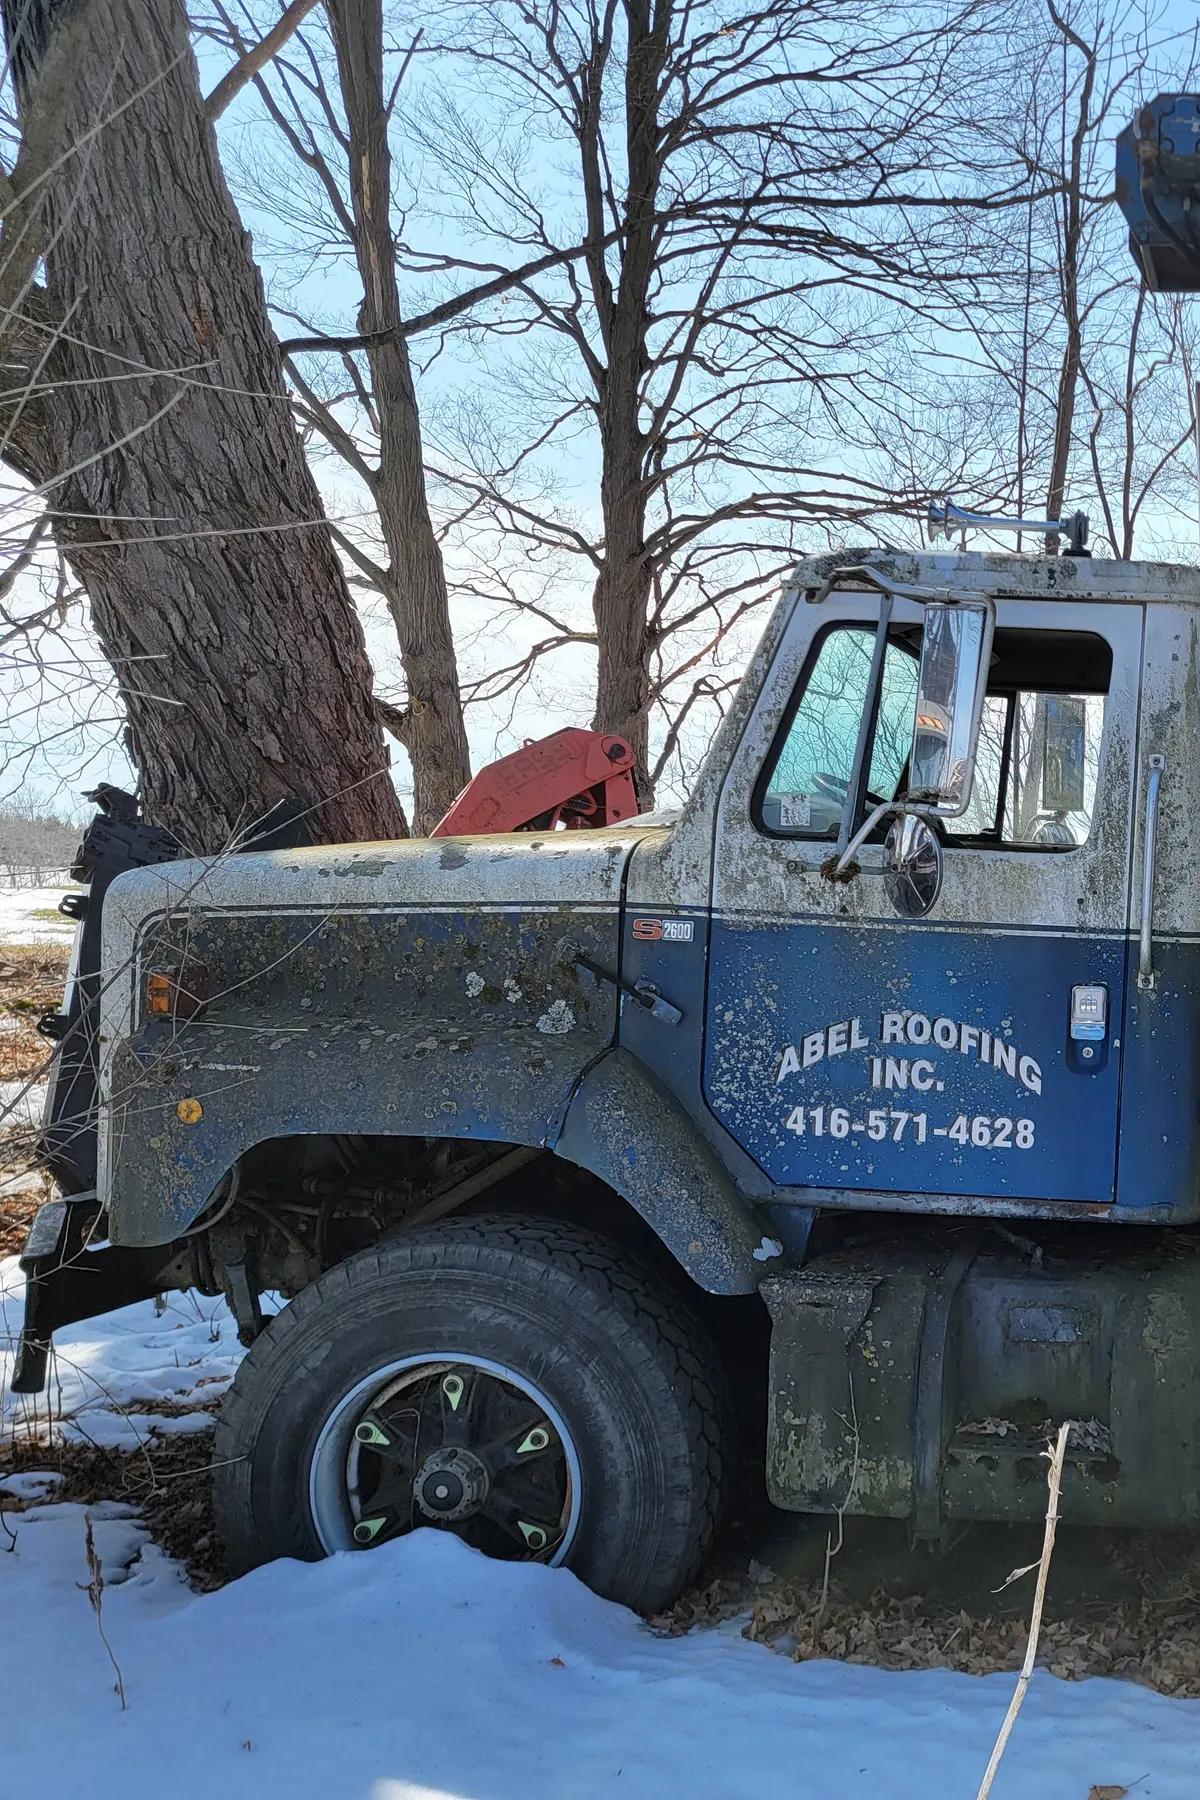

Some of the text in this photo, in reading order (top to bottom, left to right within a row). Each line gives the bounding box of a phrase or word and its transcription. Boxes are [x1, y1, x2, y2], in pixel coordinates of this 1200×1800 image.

[663, 922, 692, 939] 2600
[775, 1011, 1043, 1096] ABEL ROOFING
[870, 1057, 945, 1092] INC.
[784, 1106, 1036, 1150] 416-571-4628
